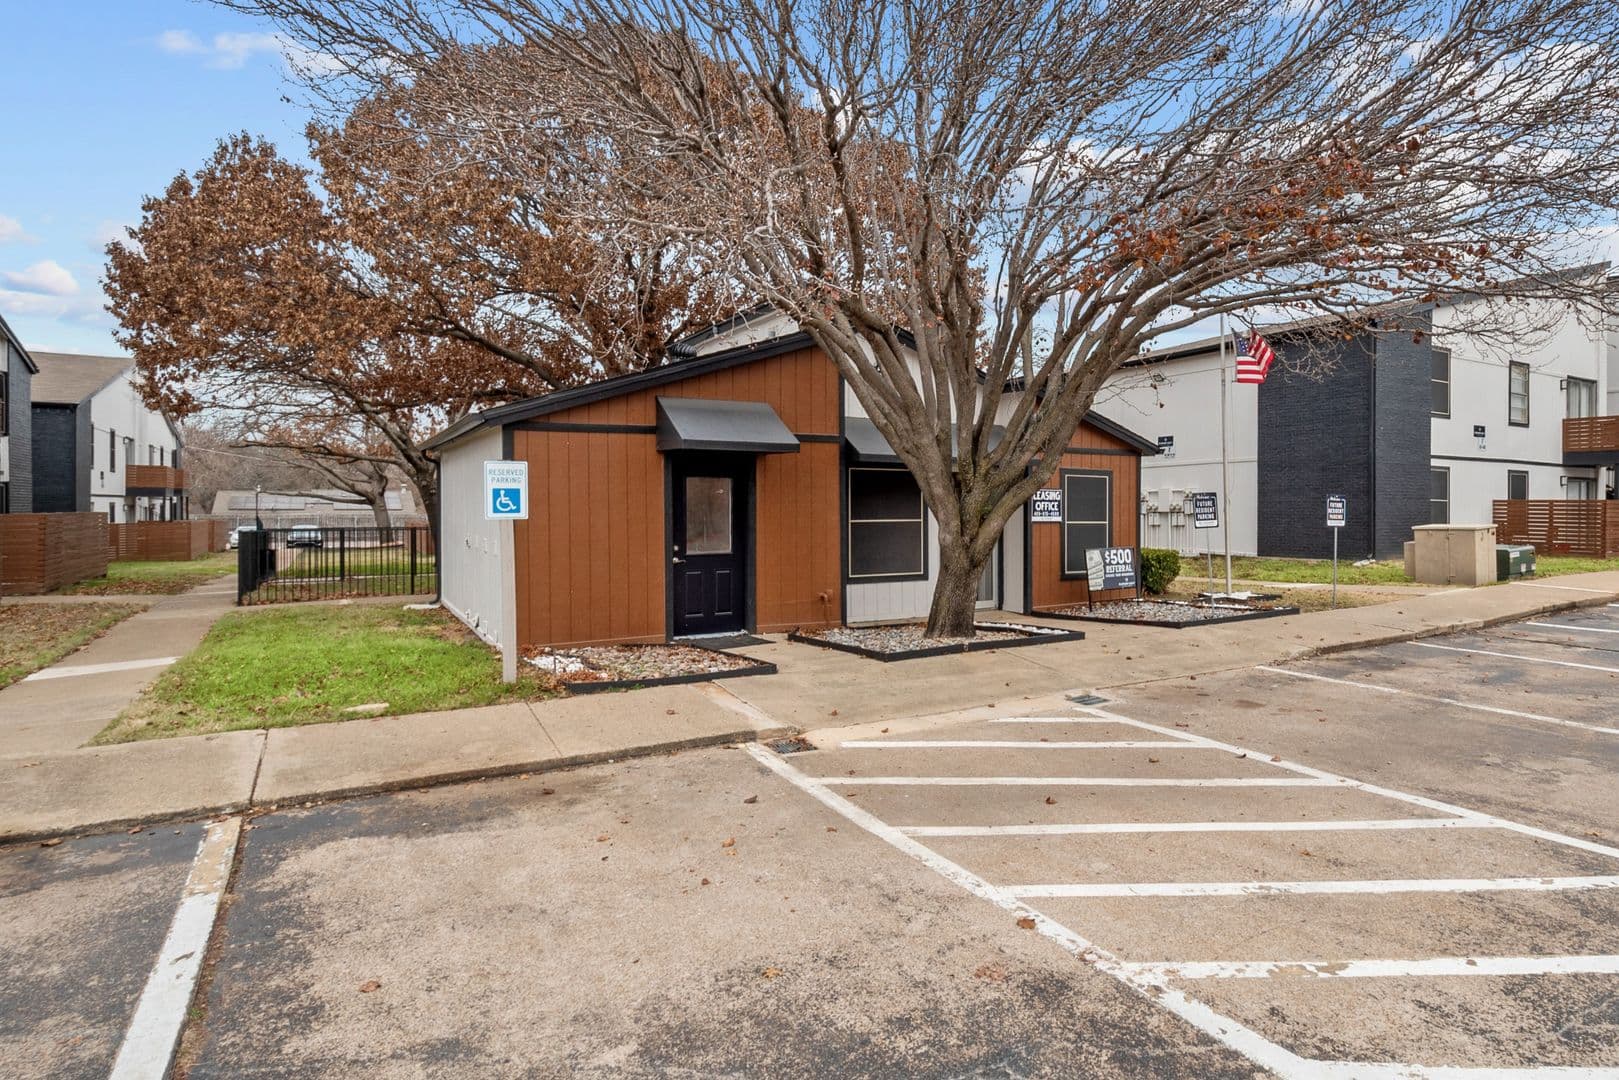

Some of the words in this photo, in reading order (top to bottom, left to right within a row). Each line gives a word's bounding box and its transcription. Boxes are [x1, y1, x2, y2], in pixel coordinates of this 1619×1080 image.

[1033, 491, 1060, 500] LEASING
[1035, 501, 1058, 511] OFFICE
[1104, 549, 1131, 564] $500
[1105, 564, 1132, 573] REFERRAL
